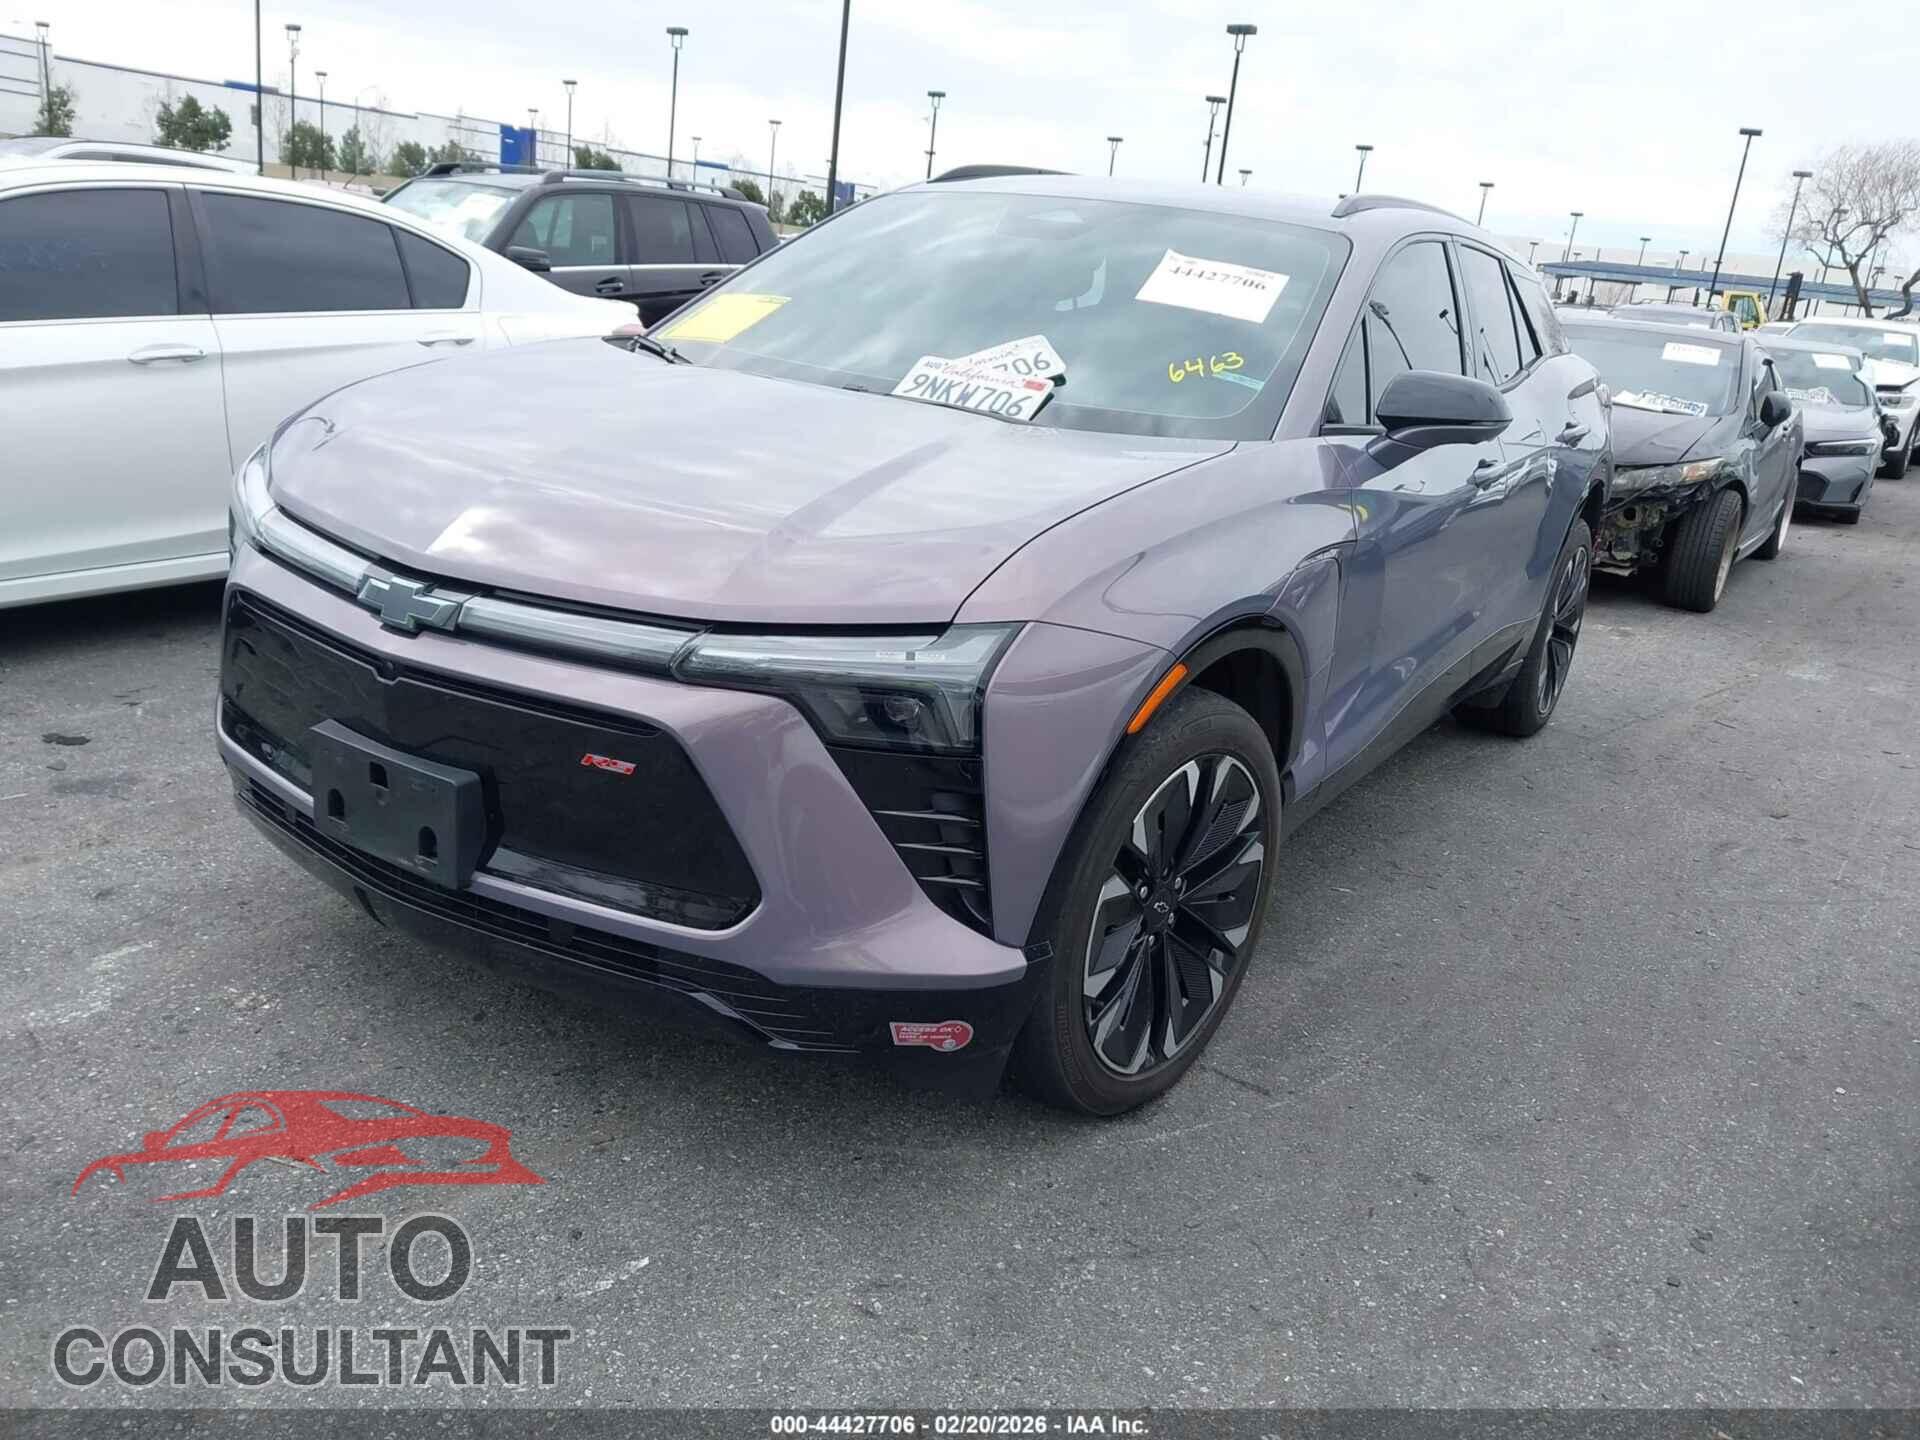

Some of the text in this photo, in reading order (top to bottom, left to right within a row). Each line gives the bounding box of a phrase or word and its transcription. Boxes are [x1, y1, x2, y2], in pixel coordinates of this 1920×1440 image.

[1168, 264, 1268, 291] 44427706
[942, 365, 1022, 389] California
[1168, 351, 1244, 382] 6463
[903, 373, 1033, 417] 9NKW706
[580, 753, 637, 775] RS
